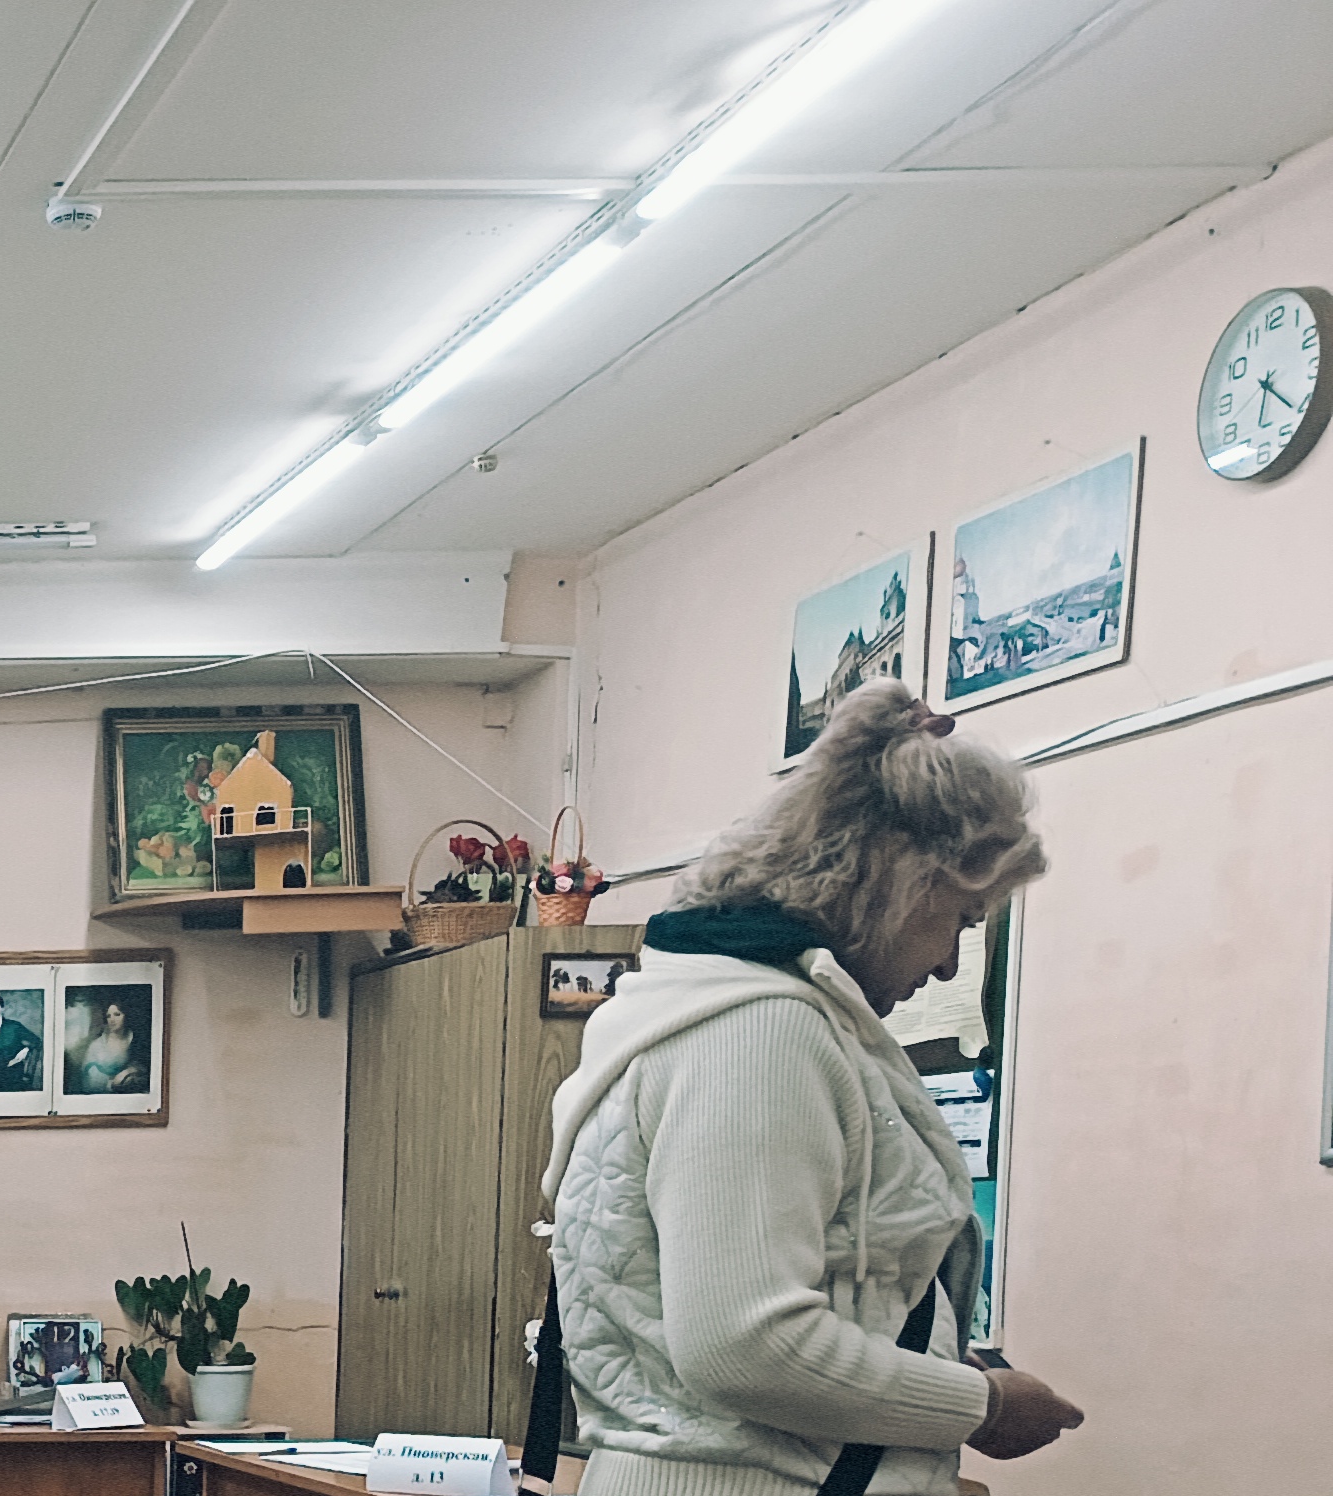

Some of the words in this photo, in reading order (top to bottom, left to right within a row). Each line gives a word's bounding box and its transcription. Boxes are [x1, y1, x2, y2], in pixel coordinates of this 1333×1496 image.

[1265, 304, 1286, 332] 12
[1295, 307, 1300, 328] 1
[1246, 326, 1260, 349] 11
[1301, 324, 1318, 351] 2
[1227, 356, 1248, 382] 10
[1218, 393, 1233, 417] 9
[1223, 422, 1237, 445] 8
[1256, 441, 1271, 465] 6
[374, 1447, 396, 1459] ул.
[400, 1445, 493, 1463] Пионерская,
[411, 1472, 424, 1483] д.
[429, 1471, 444, 1484] 13
